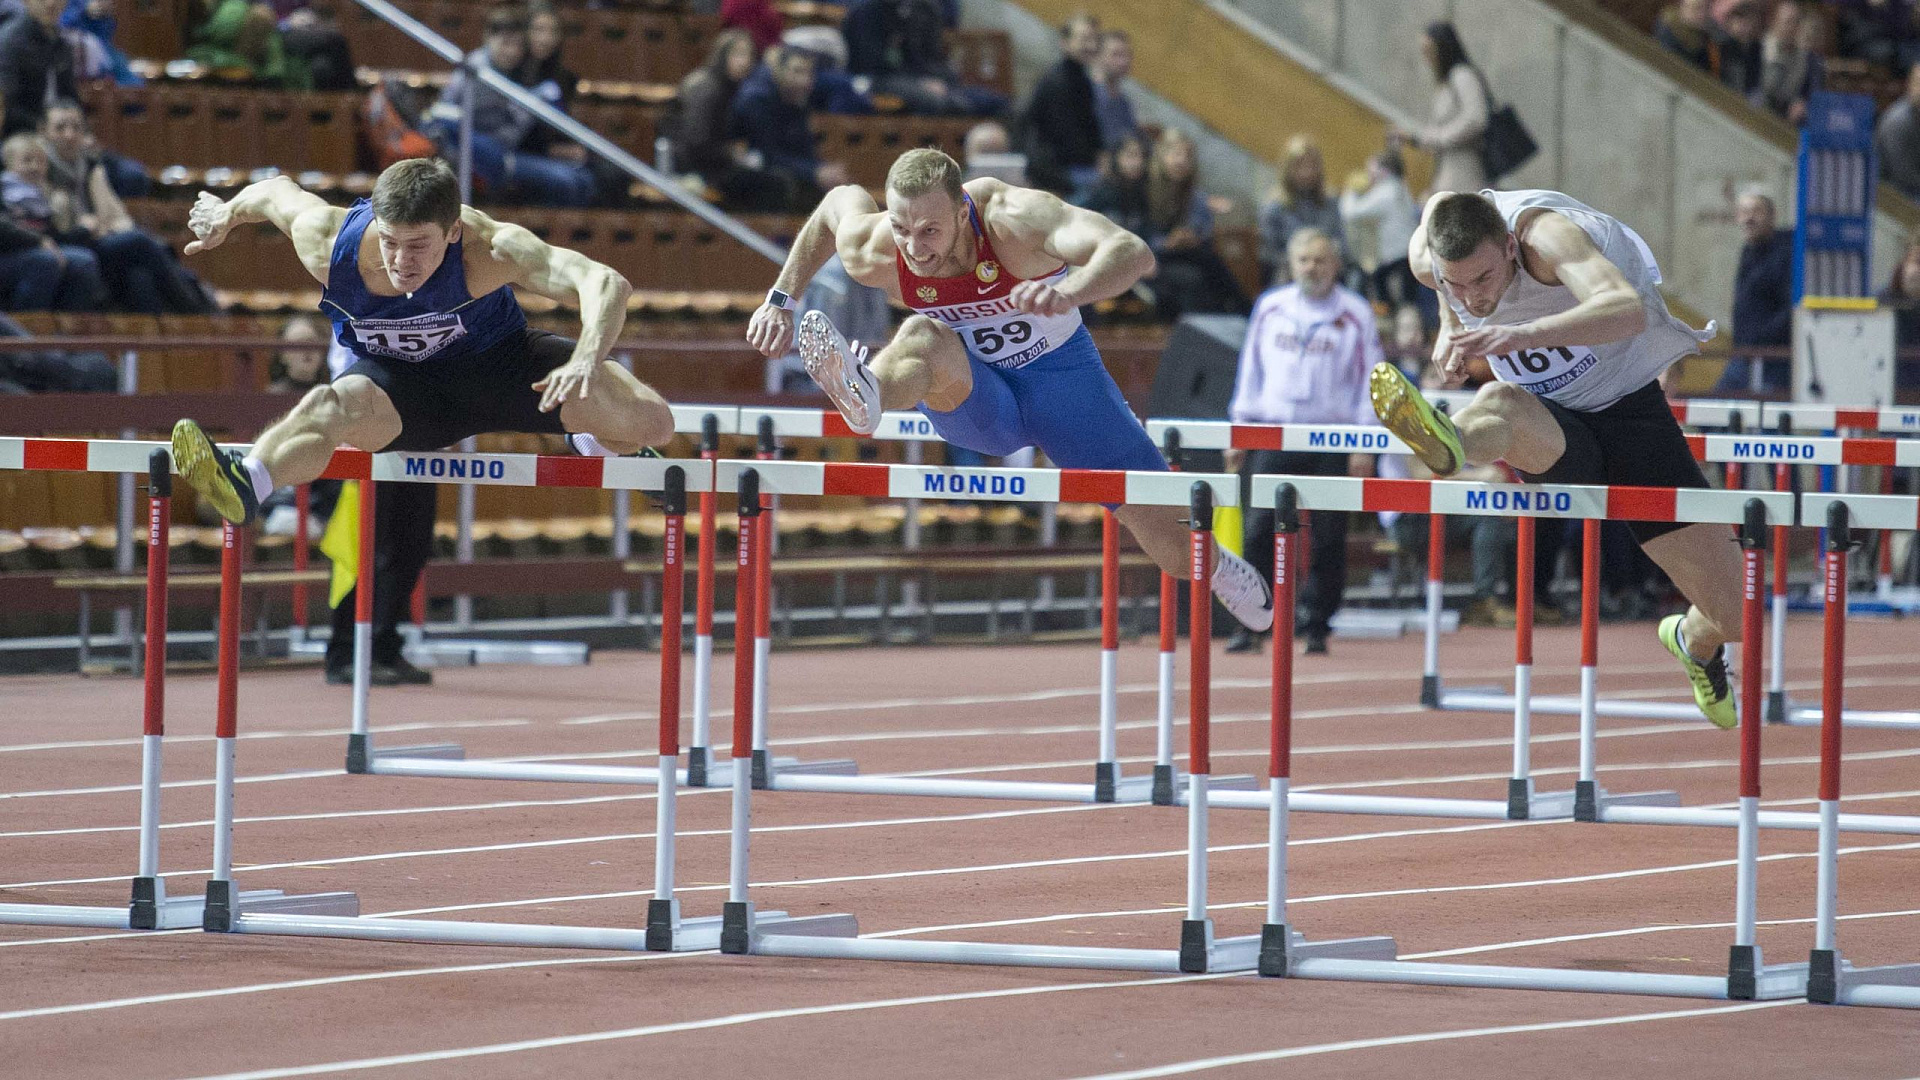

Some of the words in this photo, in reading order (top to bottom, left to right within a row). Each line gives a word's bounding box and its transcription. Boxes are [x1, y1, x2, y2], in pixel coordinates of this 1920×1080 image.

[402, 323, 438, 331] АТЛЕТИКИ
[412, 313, 456, 326] ФЕДЕРАЦИЯ
[367, 328, 456, 352] 157
[957, 320, 1032, 355] 59
[1027, 338, 1048, 359] 2017
[1545, 372, 1576, 392] ЗИМА
[1574, 355, 1595, 376] 2017
[900, 420, 937, 435] MO
[1310, 432, 1389, 448] MONDO
[1734, 443, 1814, 459] MONDO
[406, 457, 504, 479] MONDO
[925, 473, 1025, 495] MONDO
[1466, 490, 1571, 511] MONDO
